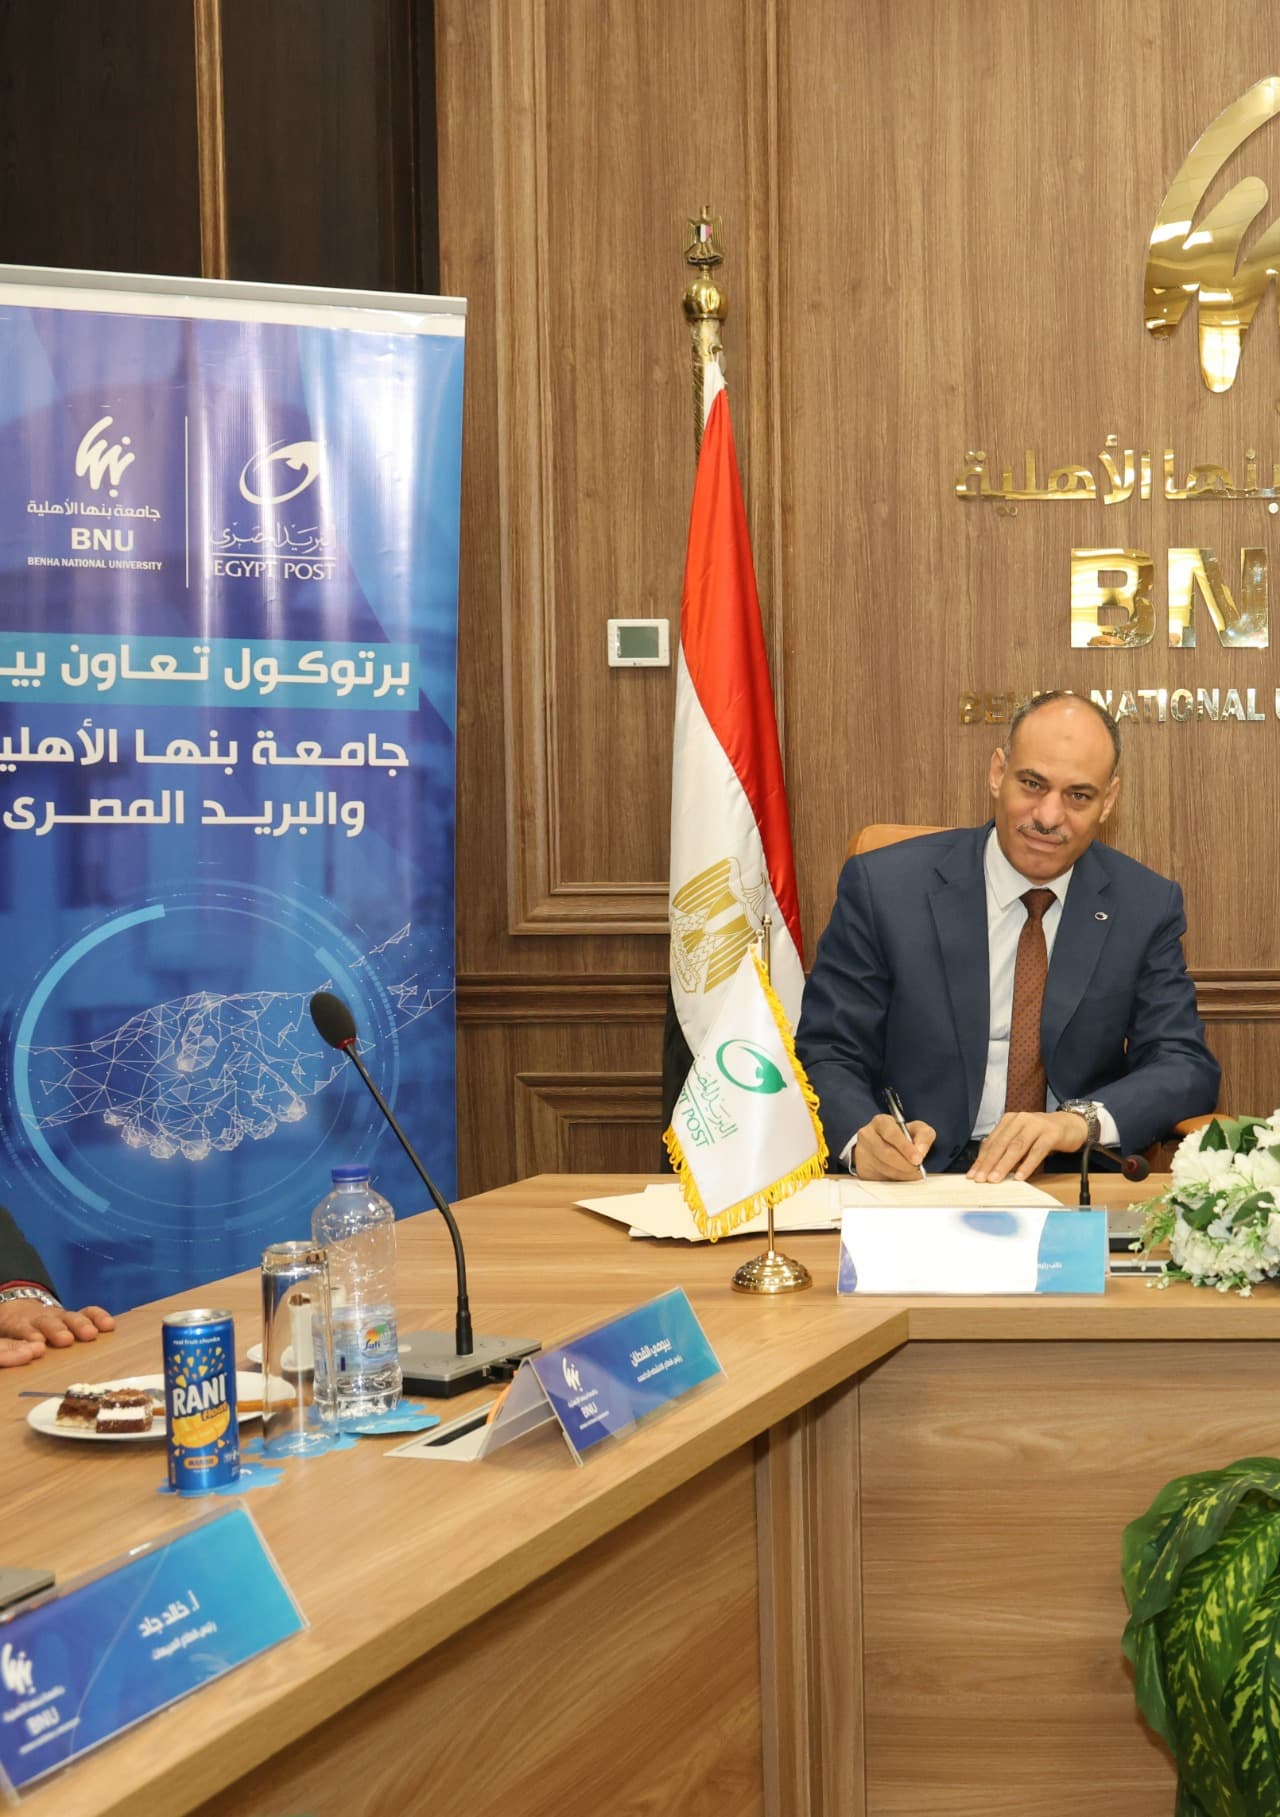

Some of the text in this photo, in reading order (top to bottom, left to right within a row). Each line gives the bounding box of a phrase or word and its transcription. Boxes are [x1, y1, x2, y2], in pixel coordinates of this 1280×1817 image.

[955, 433, 1152, 518] الأهلية
[27, 498, 161, 522] جامعة بنها الأهلية
[71, 527, 135, 552] BNU
[27, 556, 163, 571] BENHA NATIONAL UNIVERSITY
[214, 559, 337, 580] EGYPT POST
[0, 644, 411, 698] برتوكول تعاون بي
[1090, 687, 1266, 724] NATIONAL
[0, 717, 410, 777] جامعة بنها الأهلي
[2, 789, 366, 838] والبريد المصرى
[681, 1107, 711, 1148] POST
[172, 1373, 227, 1417] RANI
